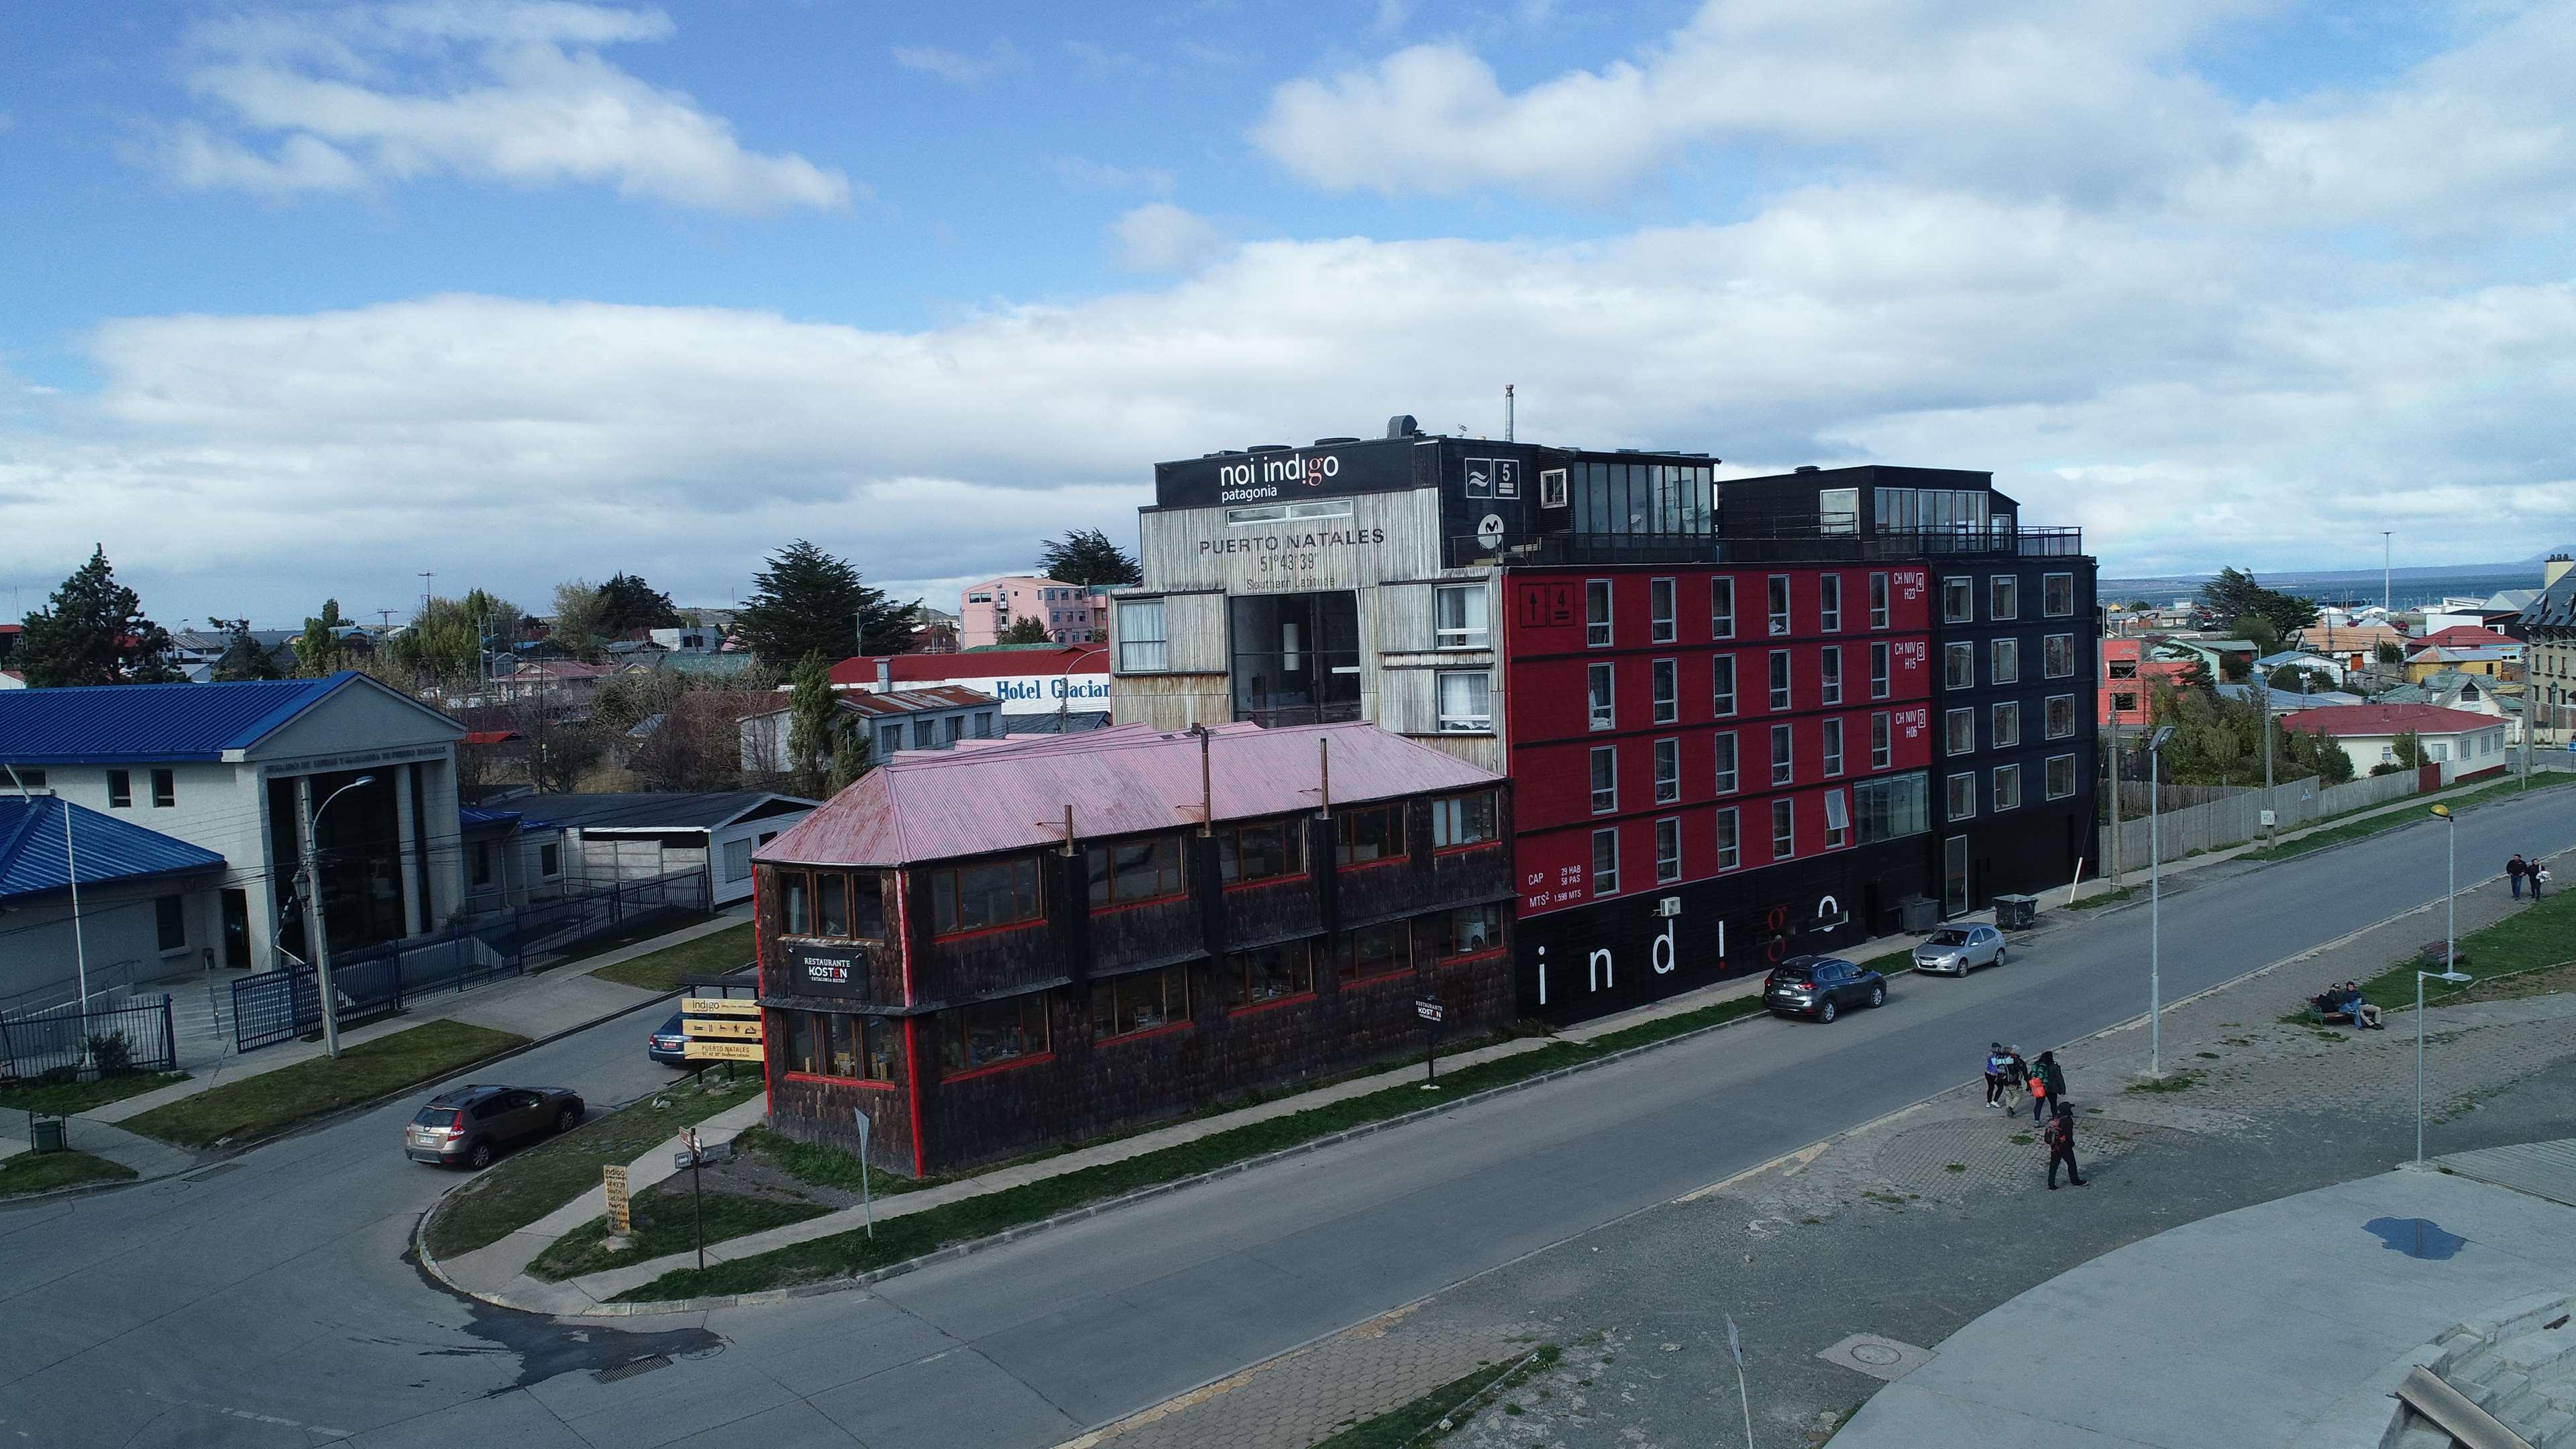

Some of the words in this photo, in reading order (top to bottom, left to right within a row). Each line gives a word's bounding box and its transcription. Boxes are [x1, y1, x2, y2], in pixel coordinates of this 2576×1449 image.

[1220, 457, 1255, 486] noi
[1264, 453, 1339, 486] indigo
[1502, 464, 1510, 482] 5
[1222, 484, 1277, 503] patagonia
[1199, 536, 1279, 555] PUERTO
[1287, 528, 1385, 549] NATALES
[1894, 572, 1902, 585] CH
[1904, 572, 1915, 584] NIV
[1558, 590, 1565, 607] 4
[1904, 588, 1916, 600] H23
[1894, 643, 1903, 655] CH
[1904, 641, 1916, 654] NIV
[1904, 657, 1916, 669] H15
[996, 680, 1042, 700] Hotel
[1896, 712, 1904, 724] CH
[1905, 710, 1917, 723] NIV
[1906, 726, 1917, 739] H06
[1528, 873, 1544, 885] CAP
[1561, 867, 1568, 876] 29
[1568, 864, 1581, 875] HAB
[1561, 877, 1568, 885] 58
[1569, 874, 1580, 884] PAS
[1568, 890, 1581, 900] MTS
[804, 957, 851, 967] RESTAURANTE
[692, 1000, 720, 1012] indigo
[1415, 1000, 1443, 1012] RESTAURANTE
